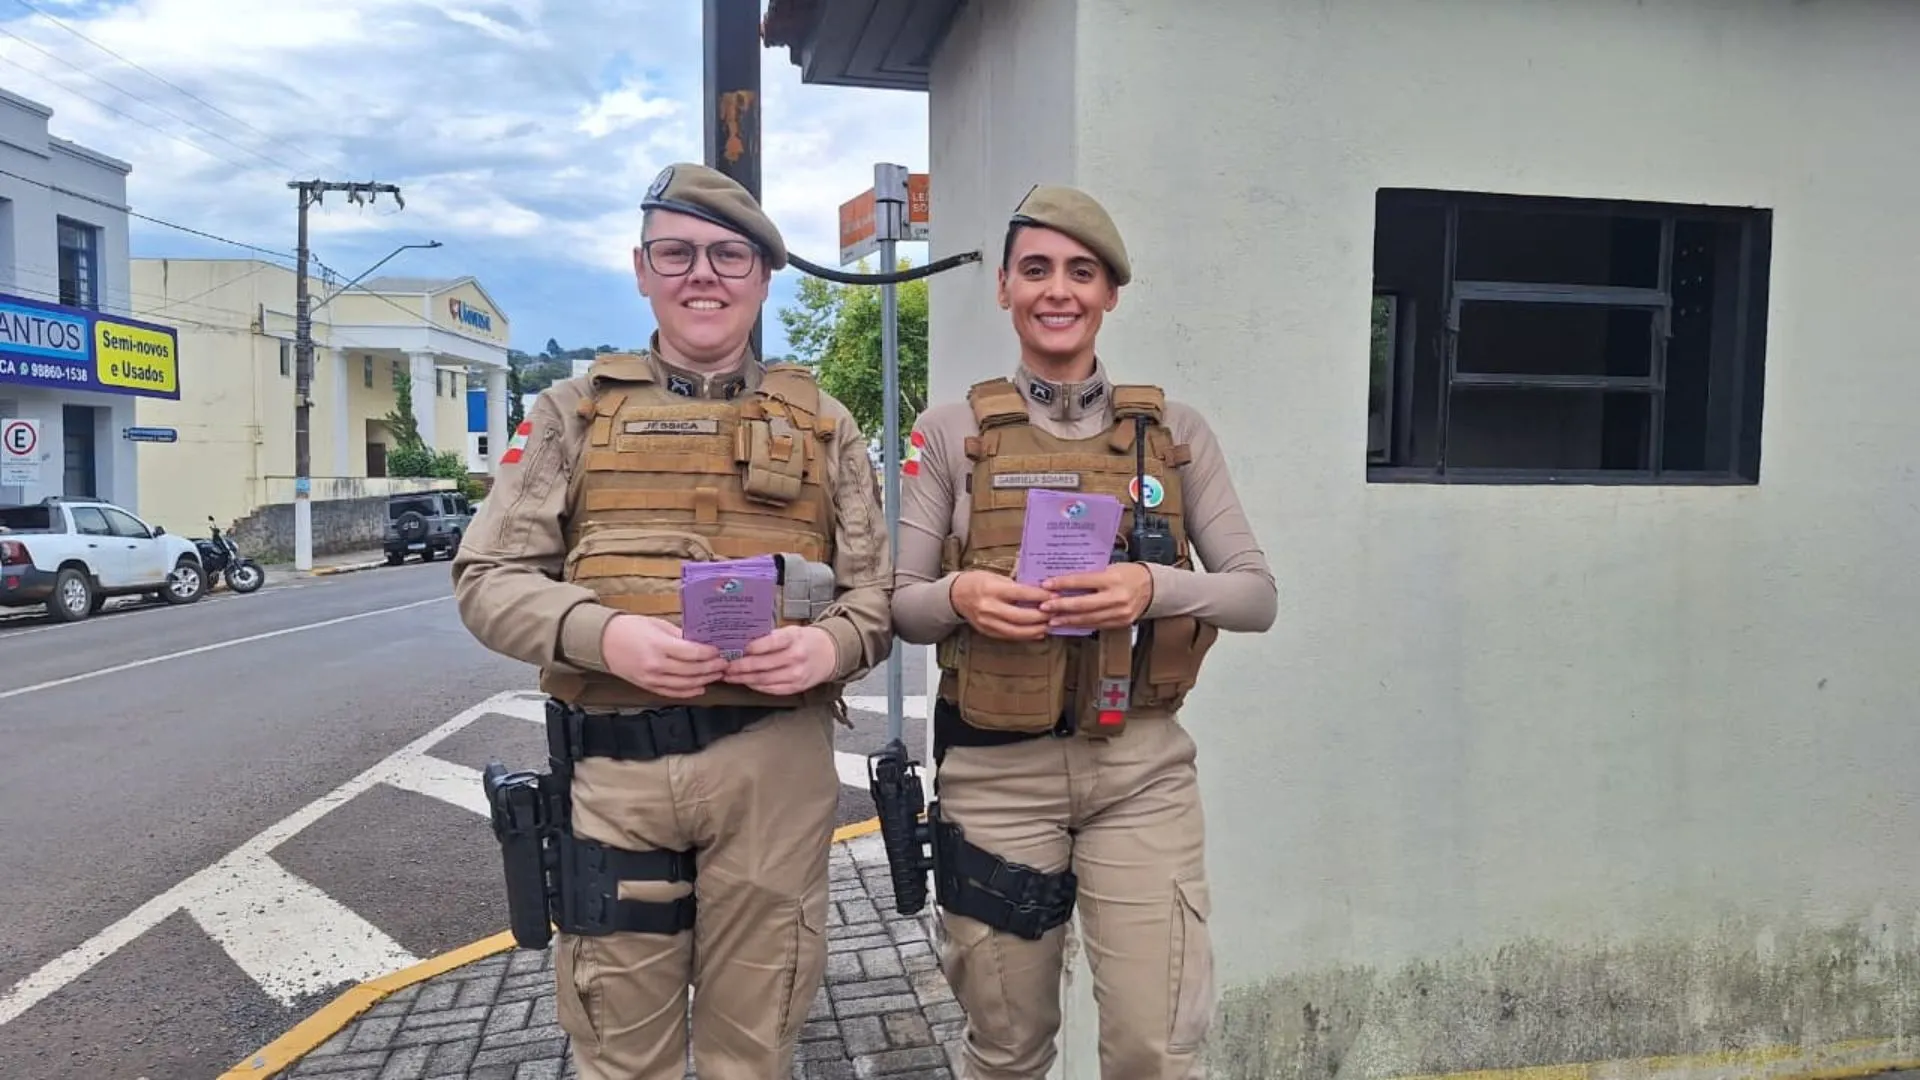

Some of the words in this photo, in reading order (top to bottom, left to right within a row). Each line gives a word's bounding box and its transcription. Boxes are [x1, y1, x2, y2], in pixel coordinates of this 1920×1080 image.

[102, 330, 169, 357] Semi-novos
[111, 364, 119, 377] e
[122, 361, 165, 383] Usados
[643, 420, 699, 430] JESSICA
[14, 429, 26, 448] E
[998, 476, 1038, 484] GABRIELA
[1041, 475, 1074, 484] SOARES
